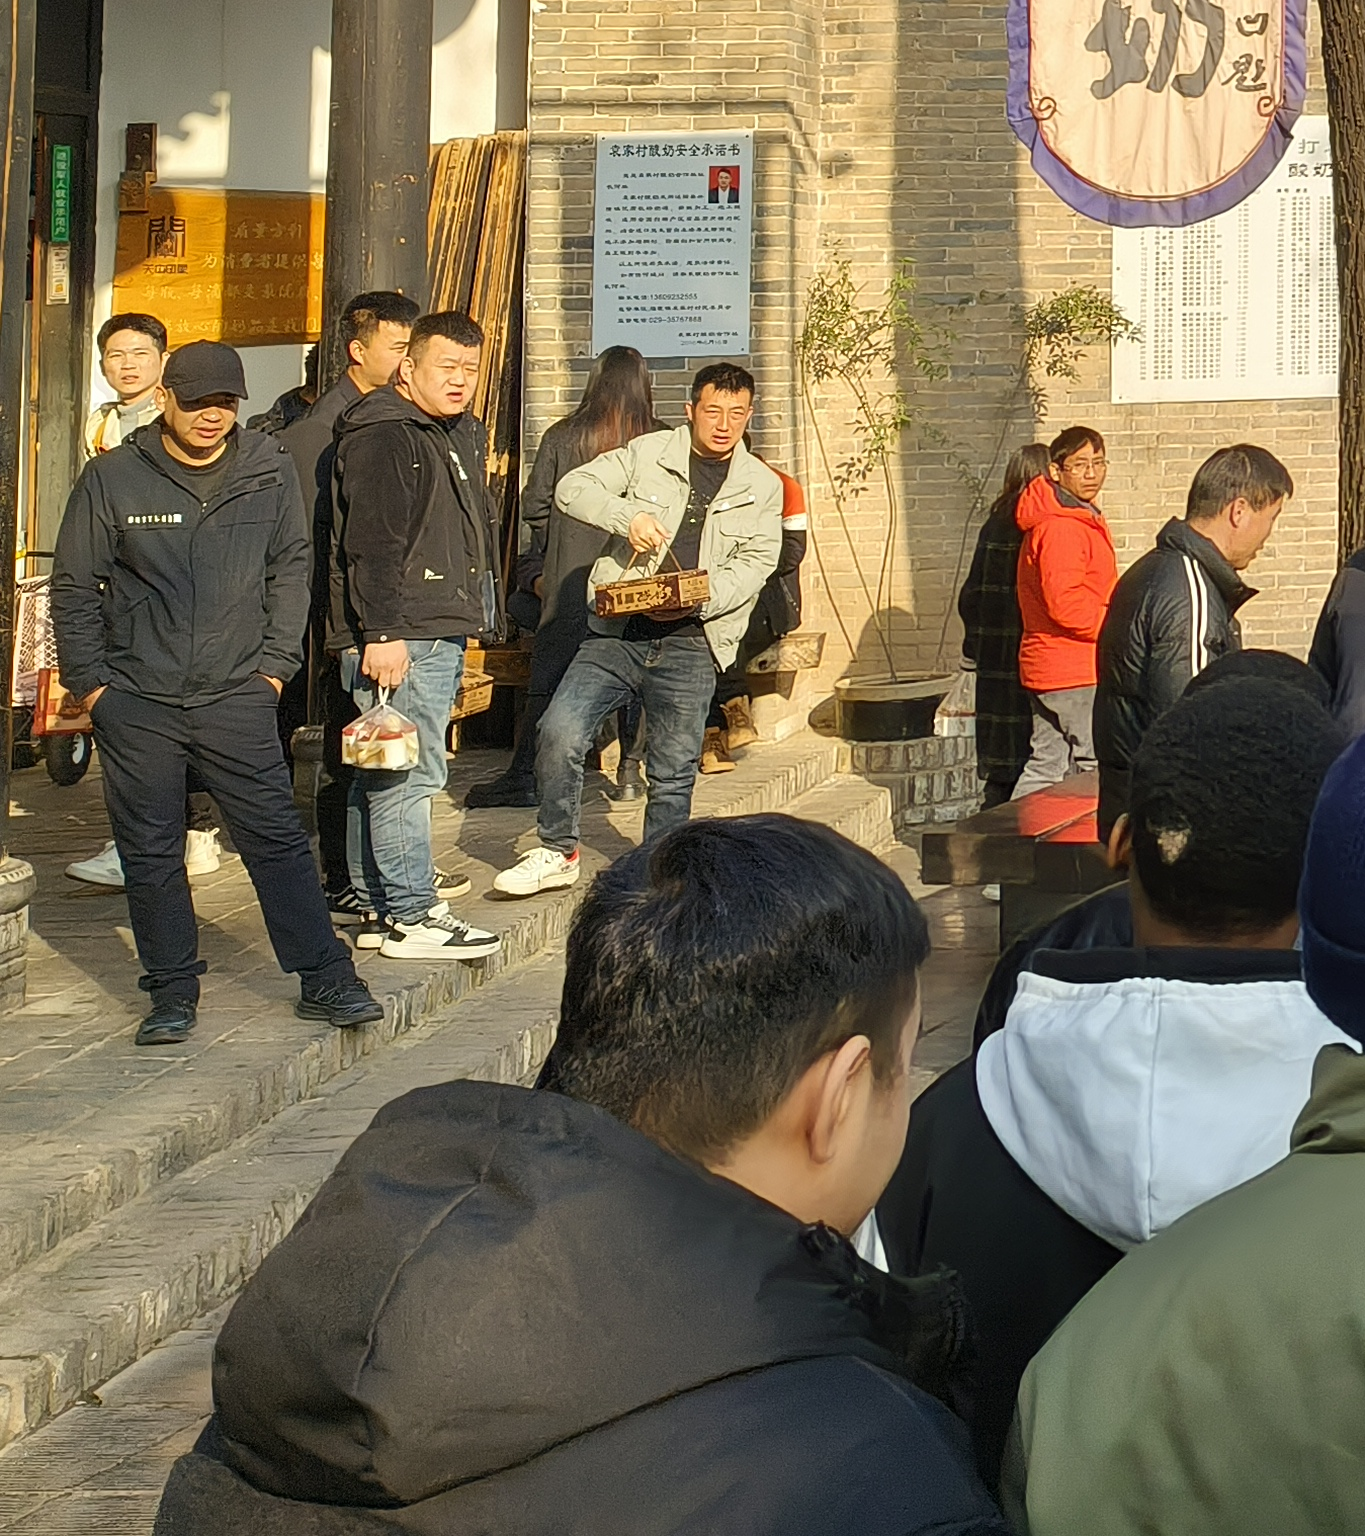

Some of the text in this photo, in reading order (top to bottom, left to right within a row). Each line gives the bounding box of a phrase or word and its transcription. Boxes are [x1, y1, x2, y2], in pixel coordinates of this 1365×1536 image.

[609, 143, 741, 158] 袁家村酸奶安全承诺书
